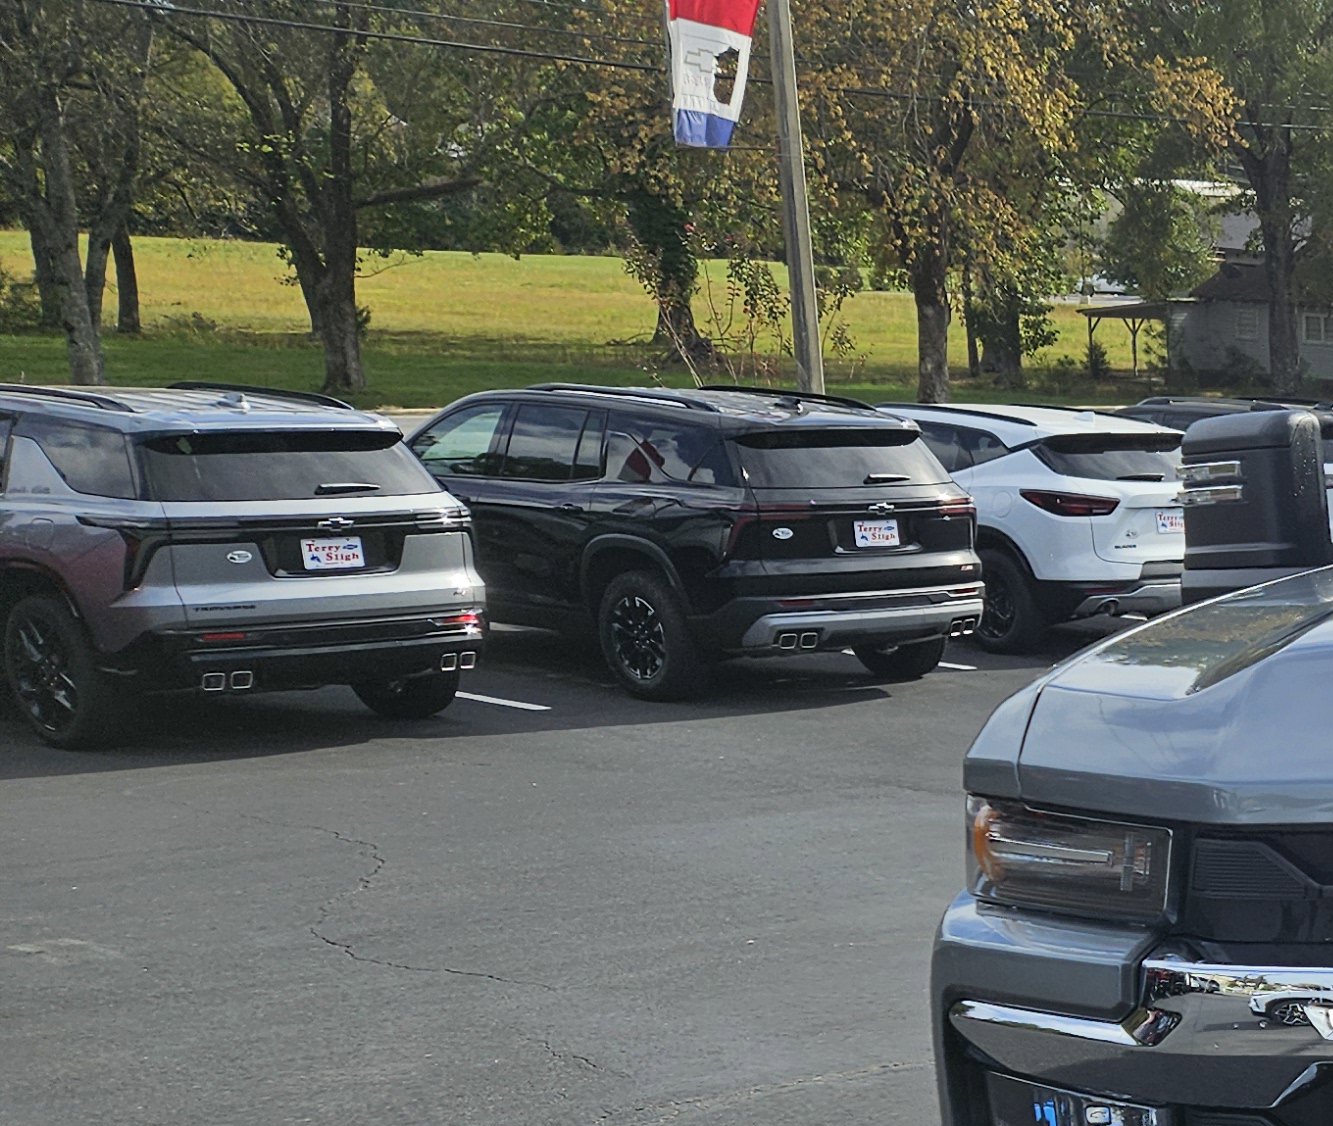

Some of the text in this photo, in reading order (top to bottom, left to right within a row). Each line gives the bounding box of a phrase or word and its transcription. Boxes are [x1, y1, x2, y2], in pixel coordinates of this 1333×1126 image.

[857, 524, 882, 533] Terry
[871, 532, 895, 541] Sligh
[306, 544, 340, 553] Terry
[326, 552, 359, 562] Sligh
